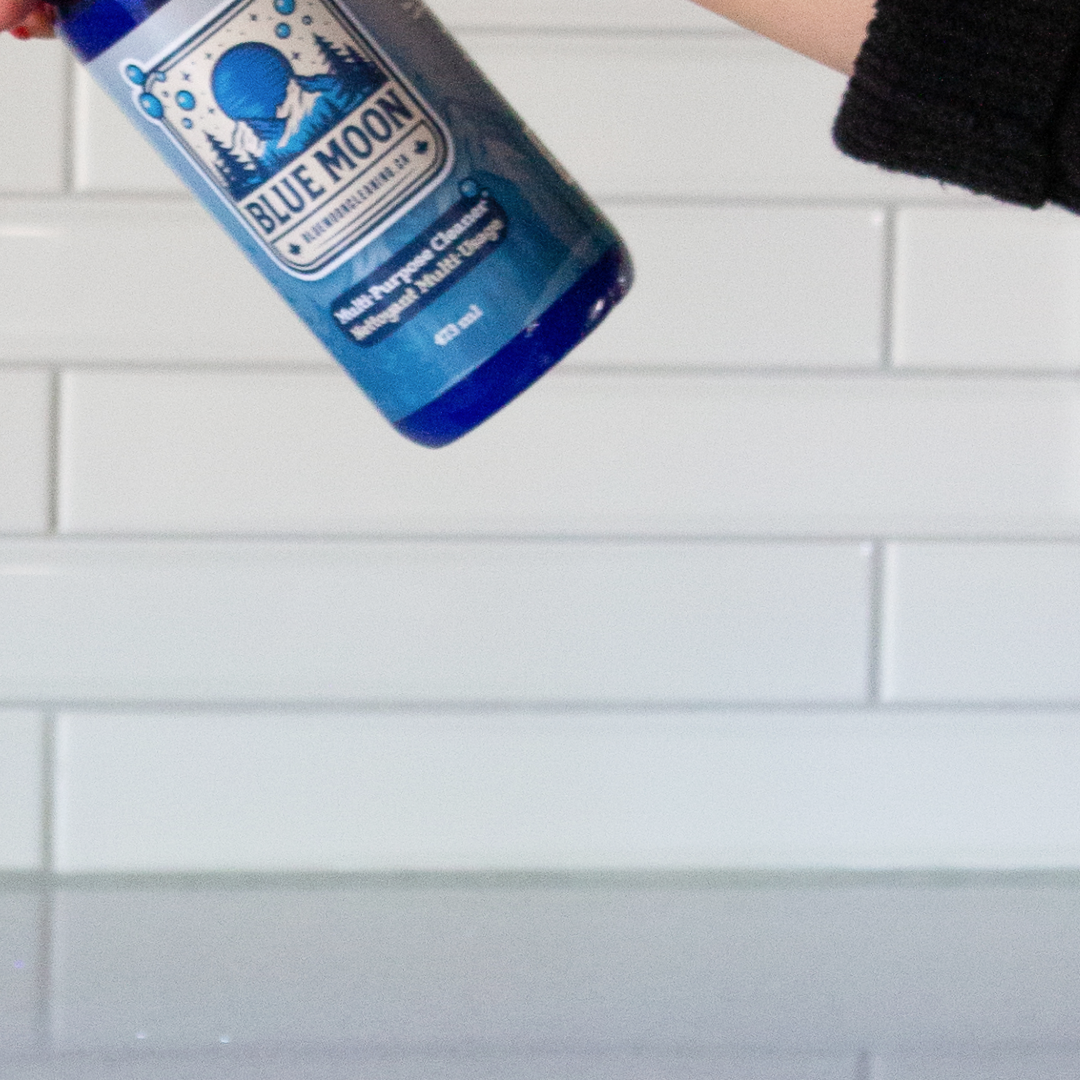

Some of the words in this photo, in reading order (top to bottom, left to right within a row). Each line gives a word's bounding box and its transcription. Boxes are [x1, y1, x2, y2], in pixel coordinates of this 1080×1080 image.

[245, 164, 326, 234] BLUE
[314, 89, 413, 183] MOON
[334, 249, 434, 324] Multi-Purpose
[350, 288, 419, 341] Nettoyant
[414, 219, 503, 294] Multi-Usage
